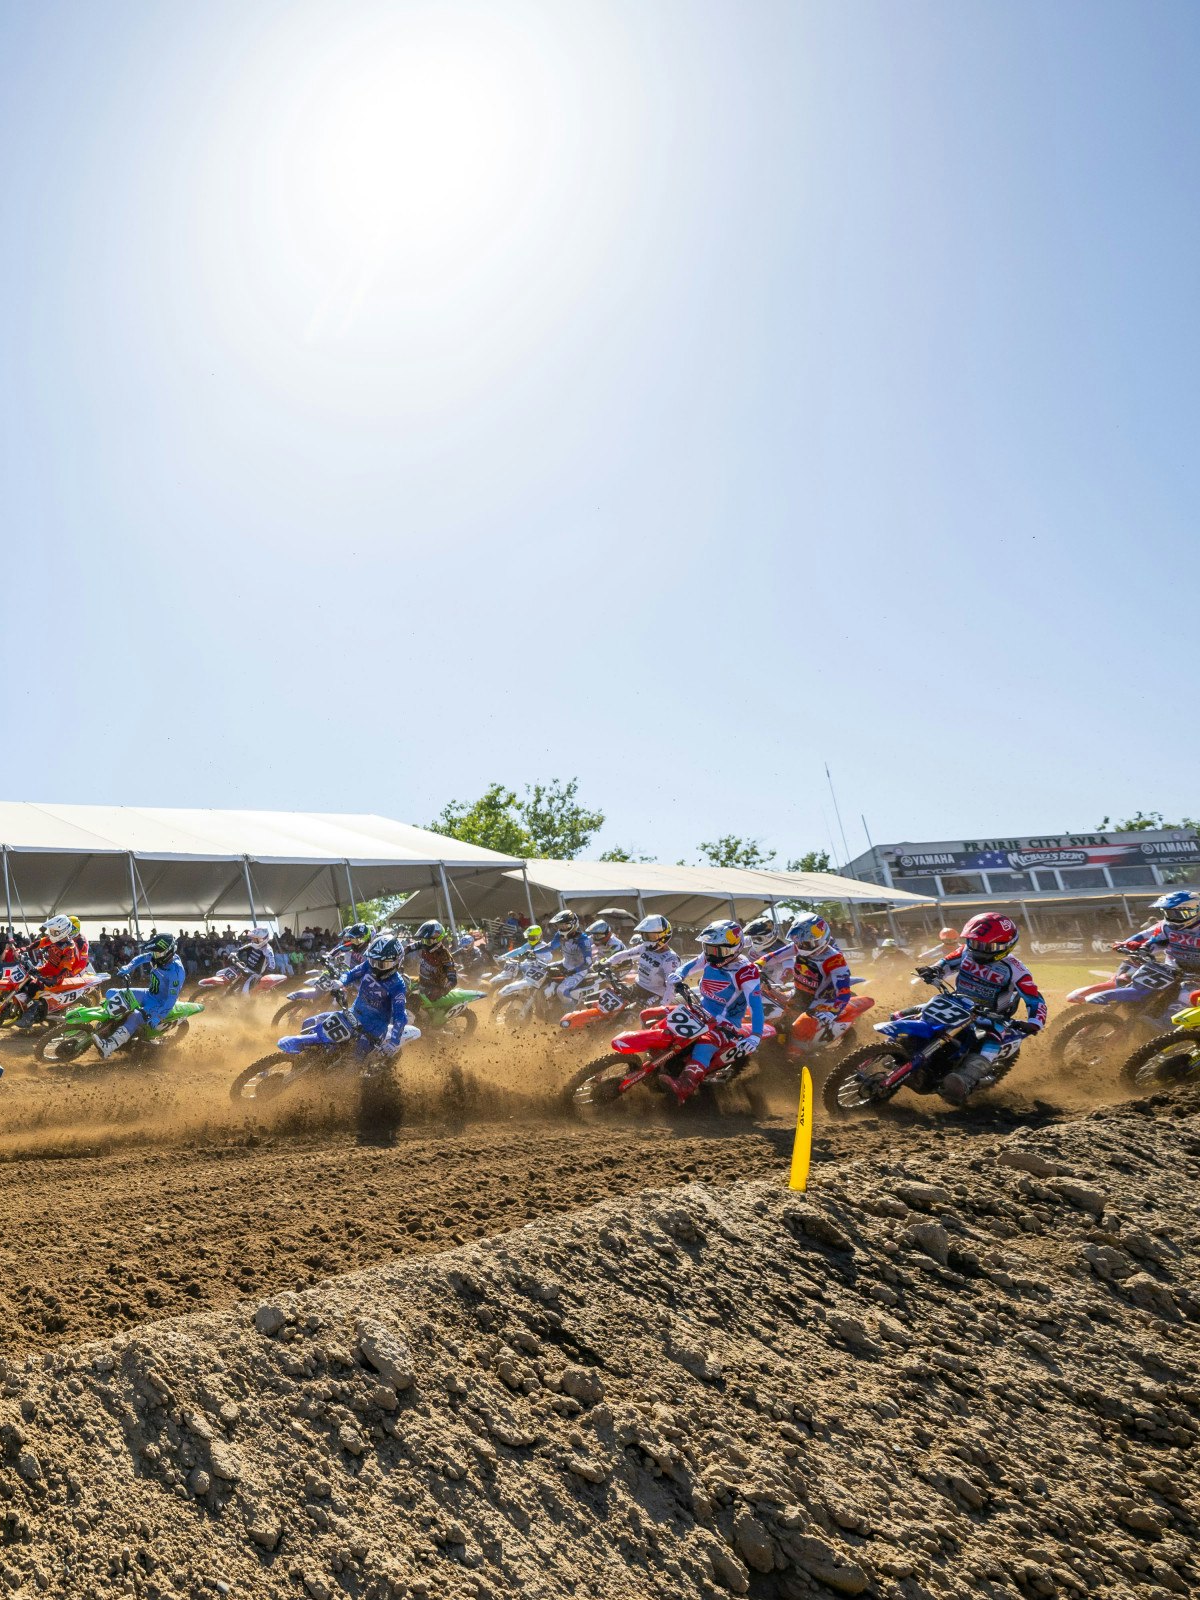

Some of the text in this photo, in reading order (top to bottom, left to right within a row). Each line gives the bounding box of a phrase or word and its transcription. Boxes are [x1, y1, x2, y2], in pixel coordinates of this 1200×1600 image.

[963, 836, 1110, 852] PRAIRIE CITY SVRA
[1153, 841, 1198, 853] YAMAHA
[912, 854, 956, 866] YAMAHA
[62, 992, 77, 1003] 79
[109, 996, 127, 1016] 21
[599, 993, 620, 1012] 53
[925, 999, 968, 1024] 23
[322, 1015, 349, 1041] 36
[667, 1012, 698, 1038] 96
